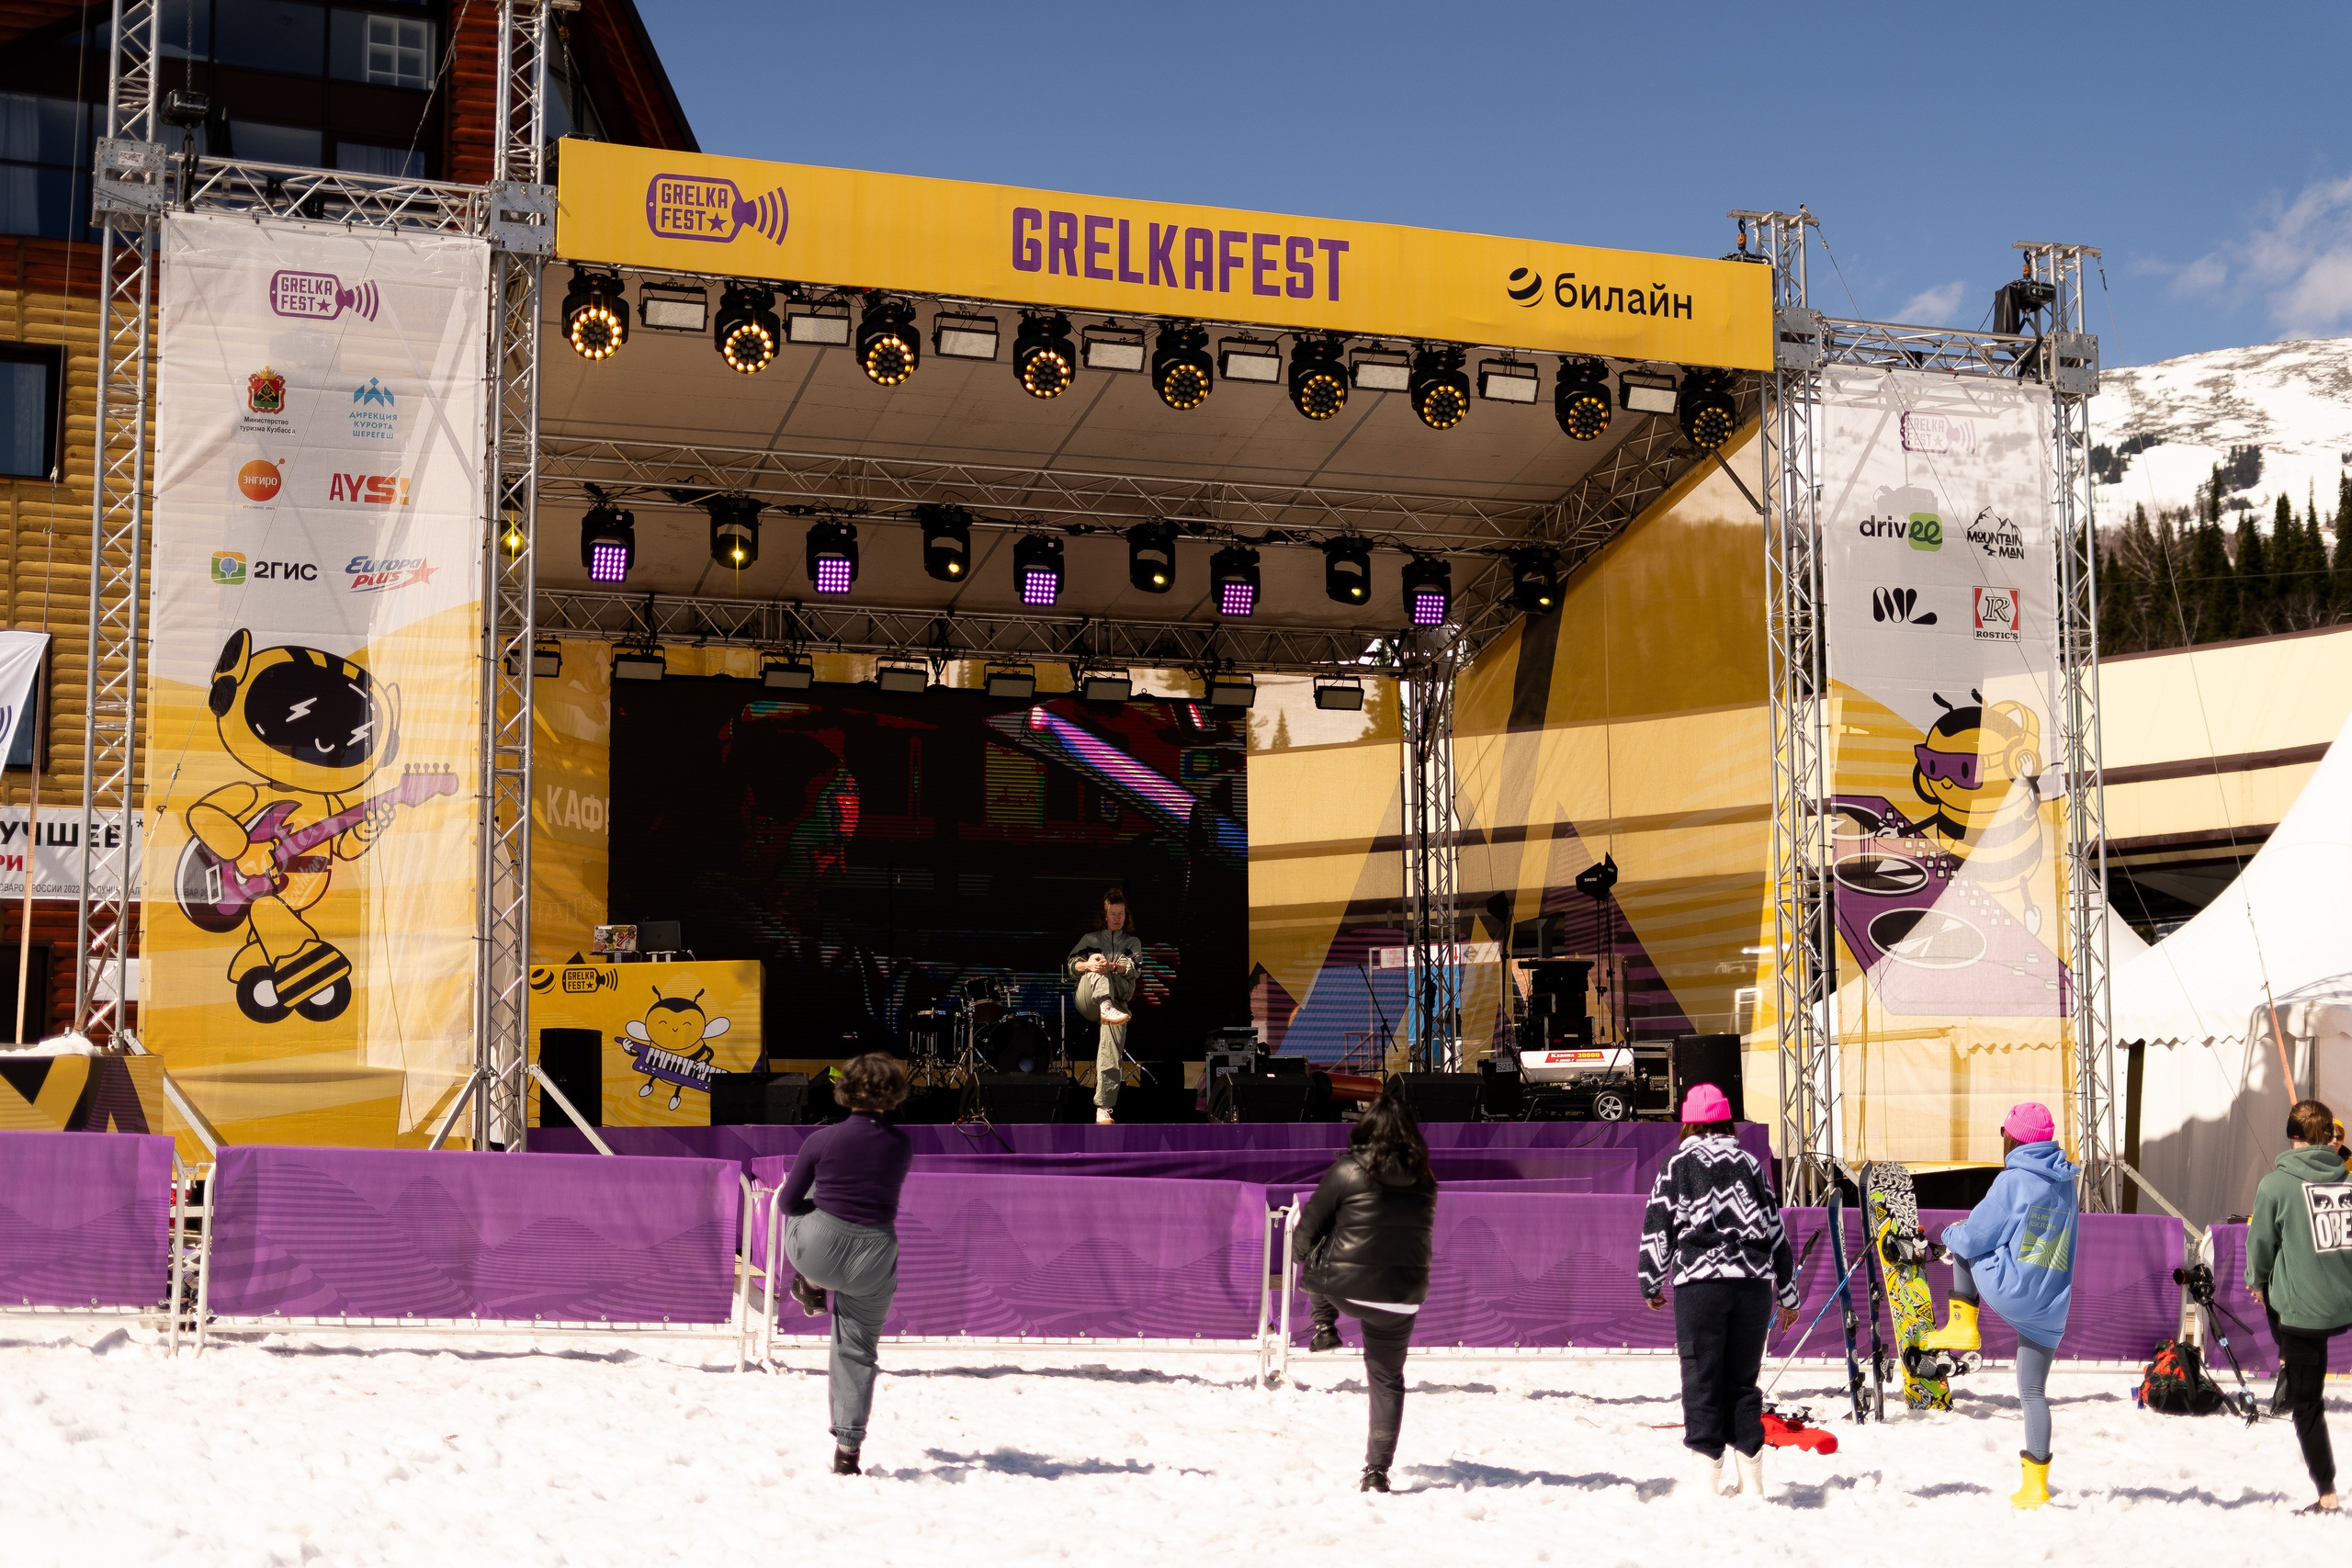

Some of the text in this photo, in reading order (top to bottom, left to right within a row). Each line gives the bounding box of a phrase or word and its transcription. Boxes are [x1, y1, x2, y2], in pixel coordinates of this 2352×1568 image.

[661, 183, 729, 209] GRELKA
[661, 208, 707, 231] FEST
[1012, 206, 1350, 302] GRELKAFEST
[280, 276, 333, 296] GRELKA
[280, 294, 315, 311] FEST
[1555, 272, 1692, 320] билайн
[243, 416, 289, 426] Министерство
[349, 412, 398, 422] ДИРЕКЦИЯ
[240, 425, 296, 434] туризма Кузбасса
[354, 421, 393, 431] КУРОРТА
[352, 430, 394, 440] ШЕРЕГЕШ
[243, 475, 277, 488] энгиро
[329, 473, 411, 506] AYS!
[1859, 515, 1943, 546] drivee
[1966, 530, 2023, 547] MOUNTAIN
[1998, 546, 2025, 560] MAN
[254, 560, 318, 581] 2ГИС
[345, 555, 423, 575] Europa
[1975, 630, 2018, 640] ROSTIC'S
[567, 971, 594, 981] GRELKA
[567, 980, 586, 990] FEST
[2315, 1211, 2352, 1248] OBE
